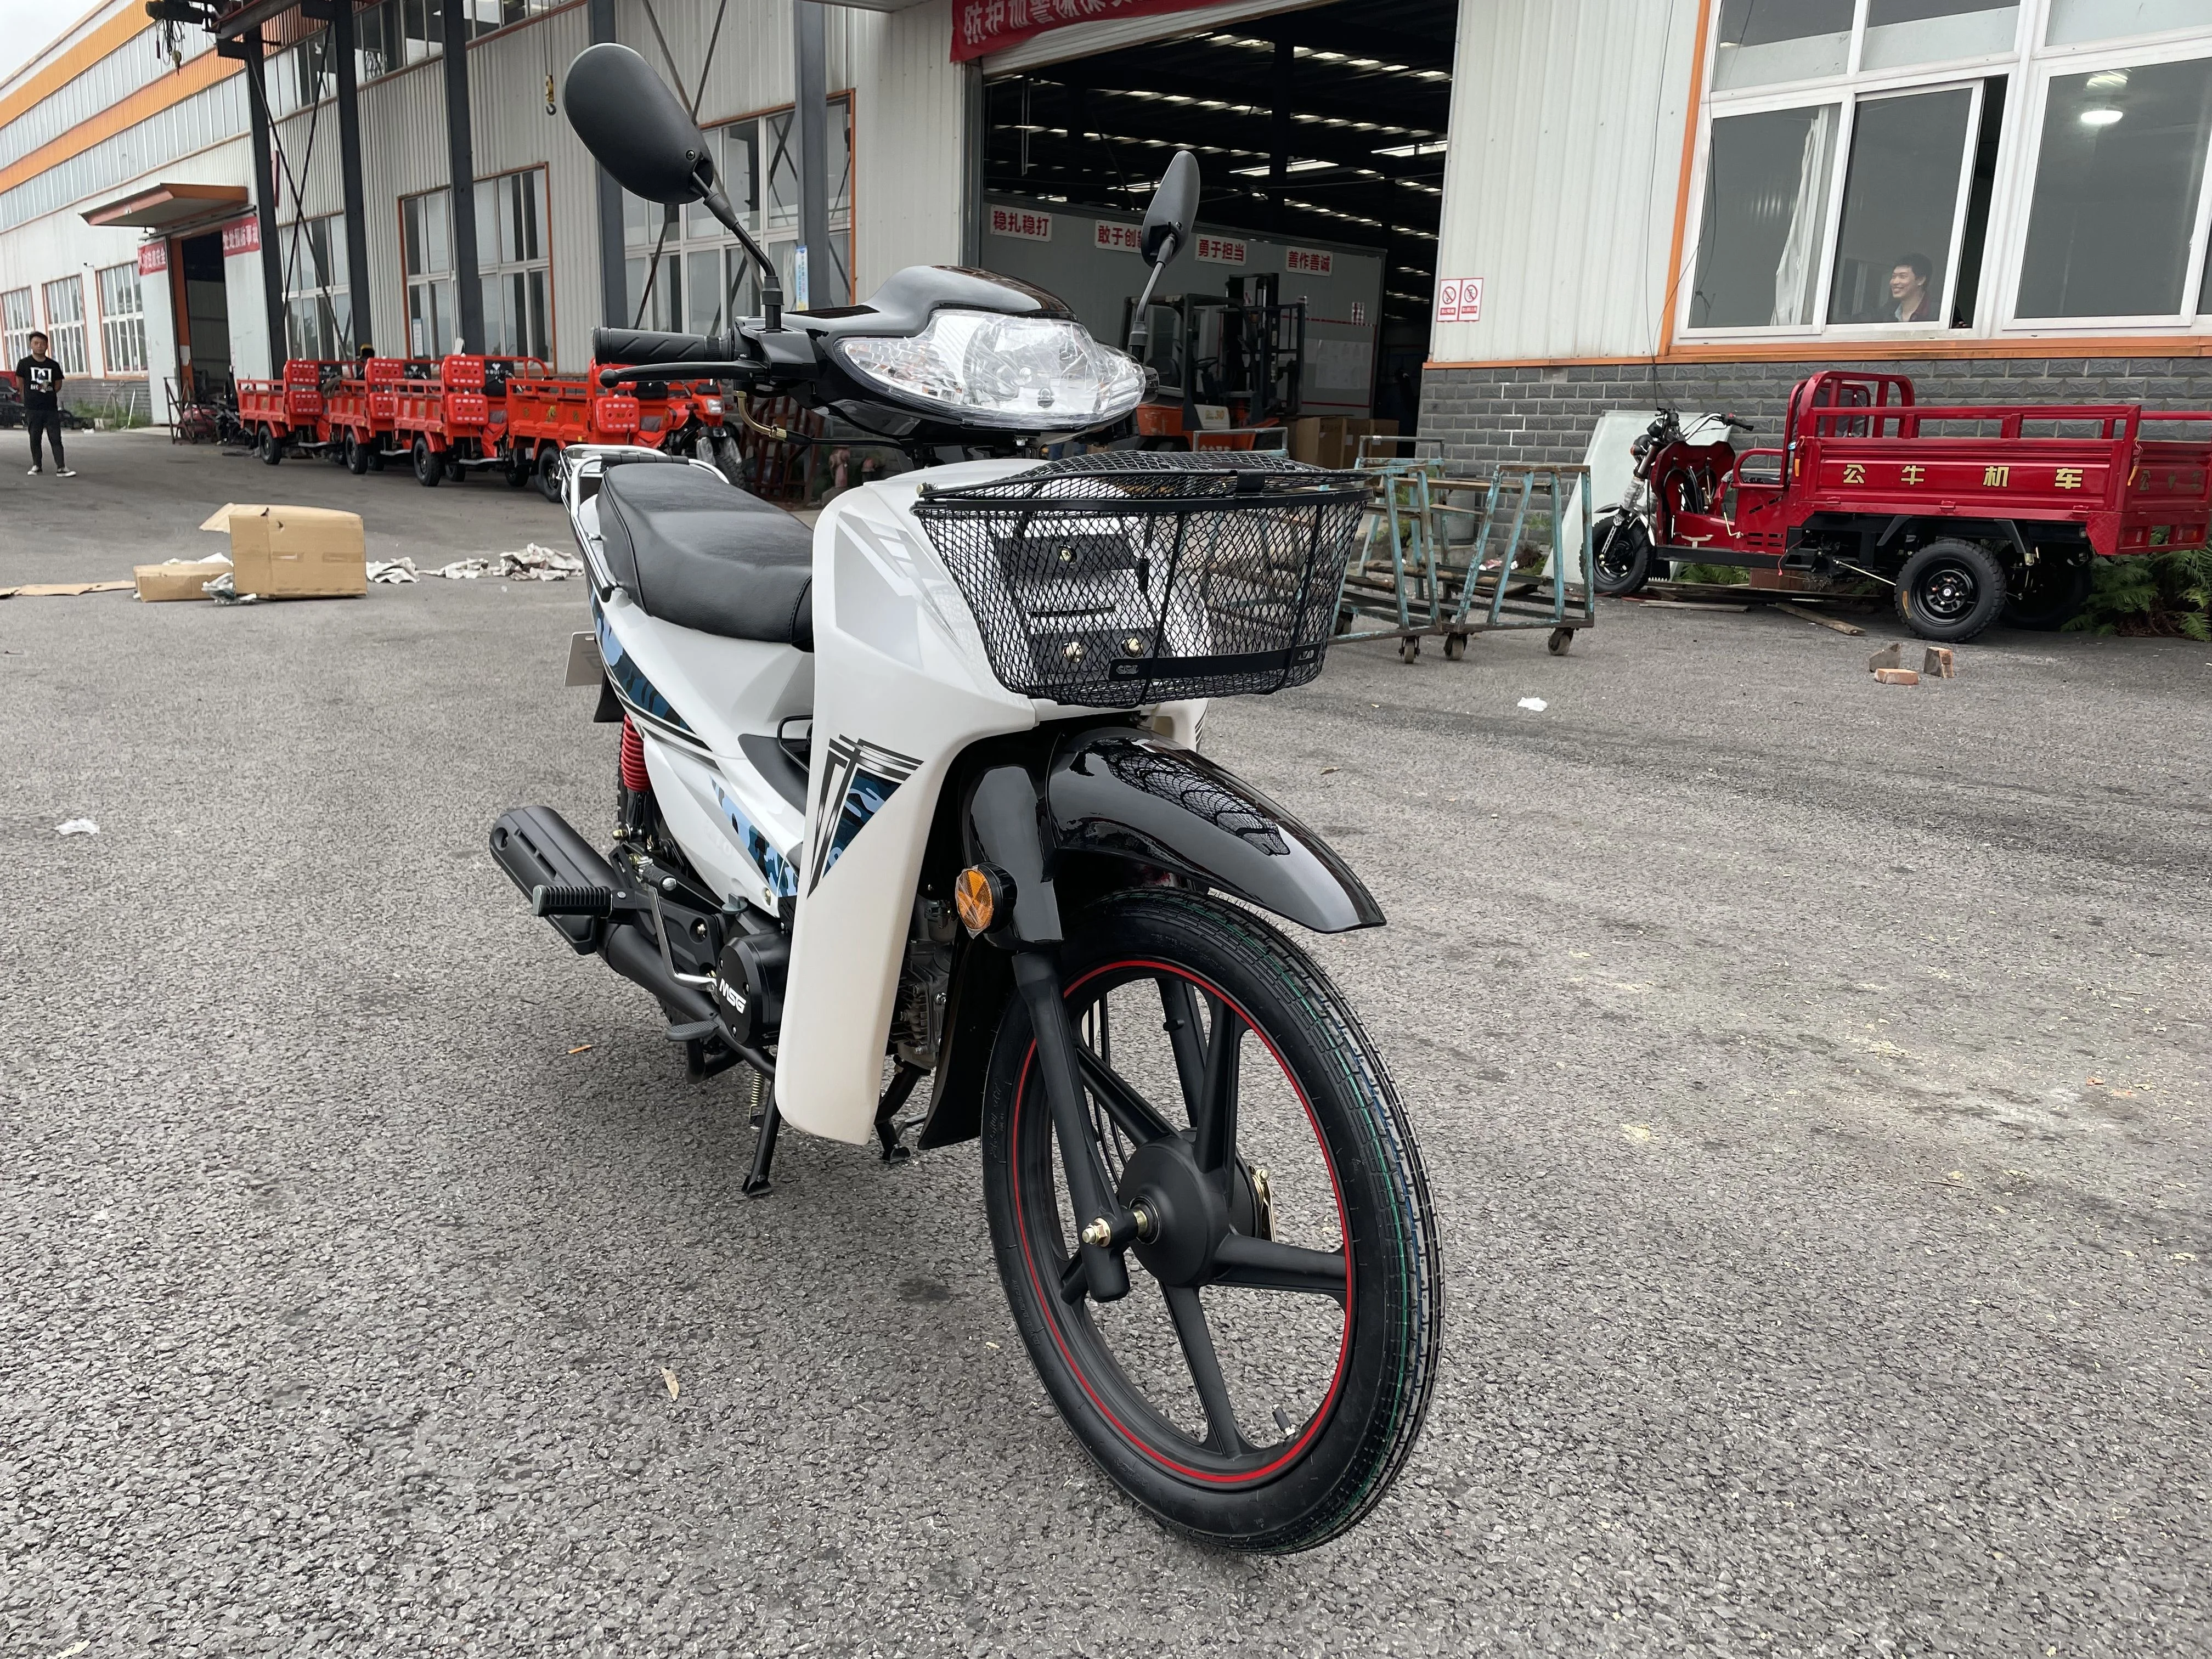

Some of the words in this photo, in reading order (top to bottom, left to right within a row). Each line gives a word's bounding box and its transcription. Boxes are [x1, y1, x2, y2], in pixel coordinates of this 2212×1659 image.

[994, 210, 1049, 236] 稳扎稳打
[1198, 239, 1245, 262] 勇于担当
[1843, 464, 2084, 490] 公牛机车
[719, 978, 747, 1014] MSG
